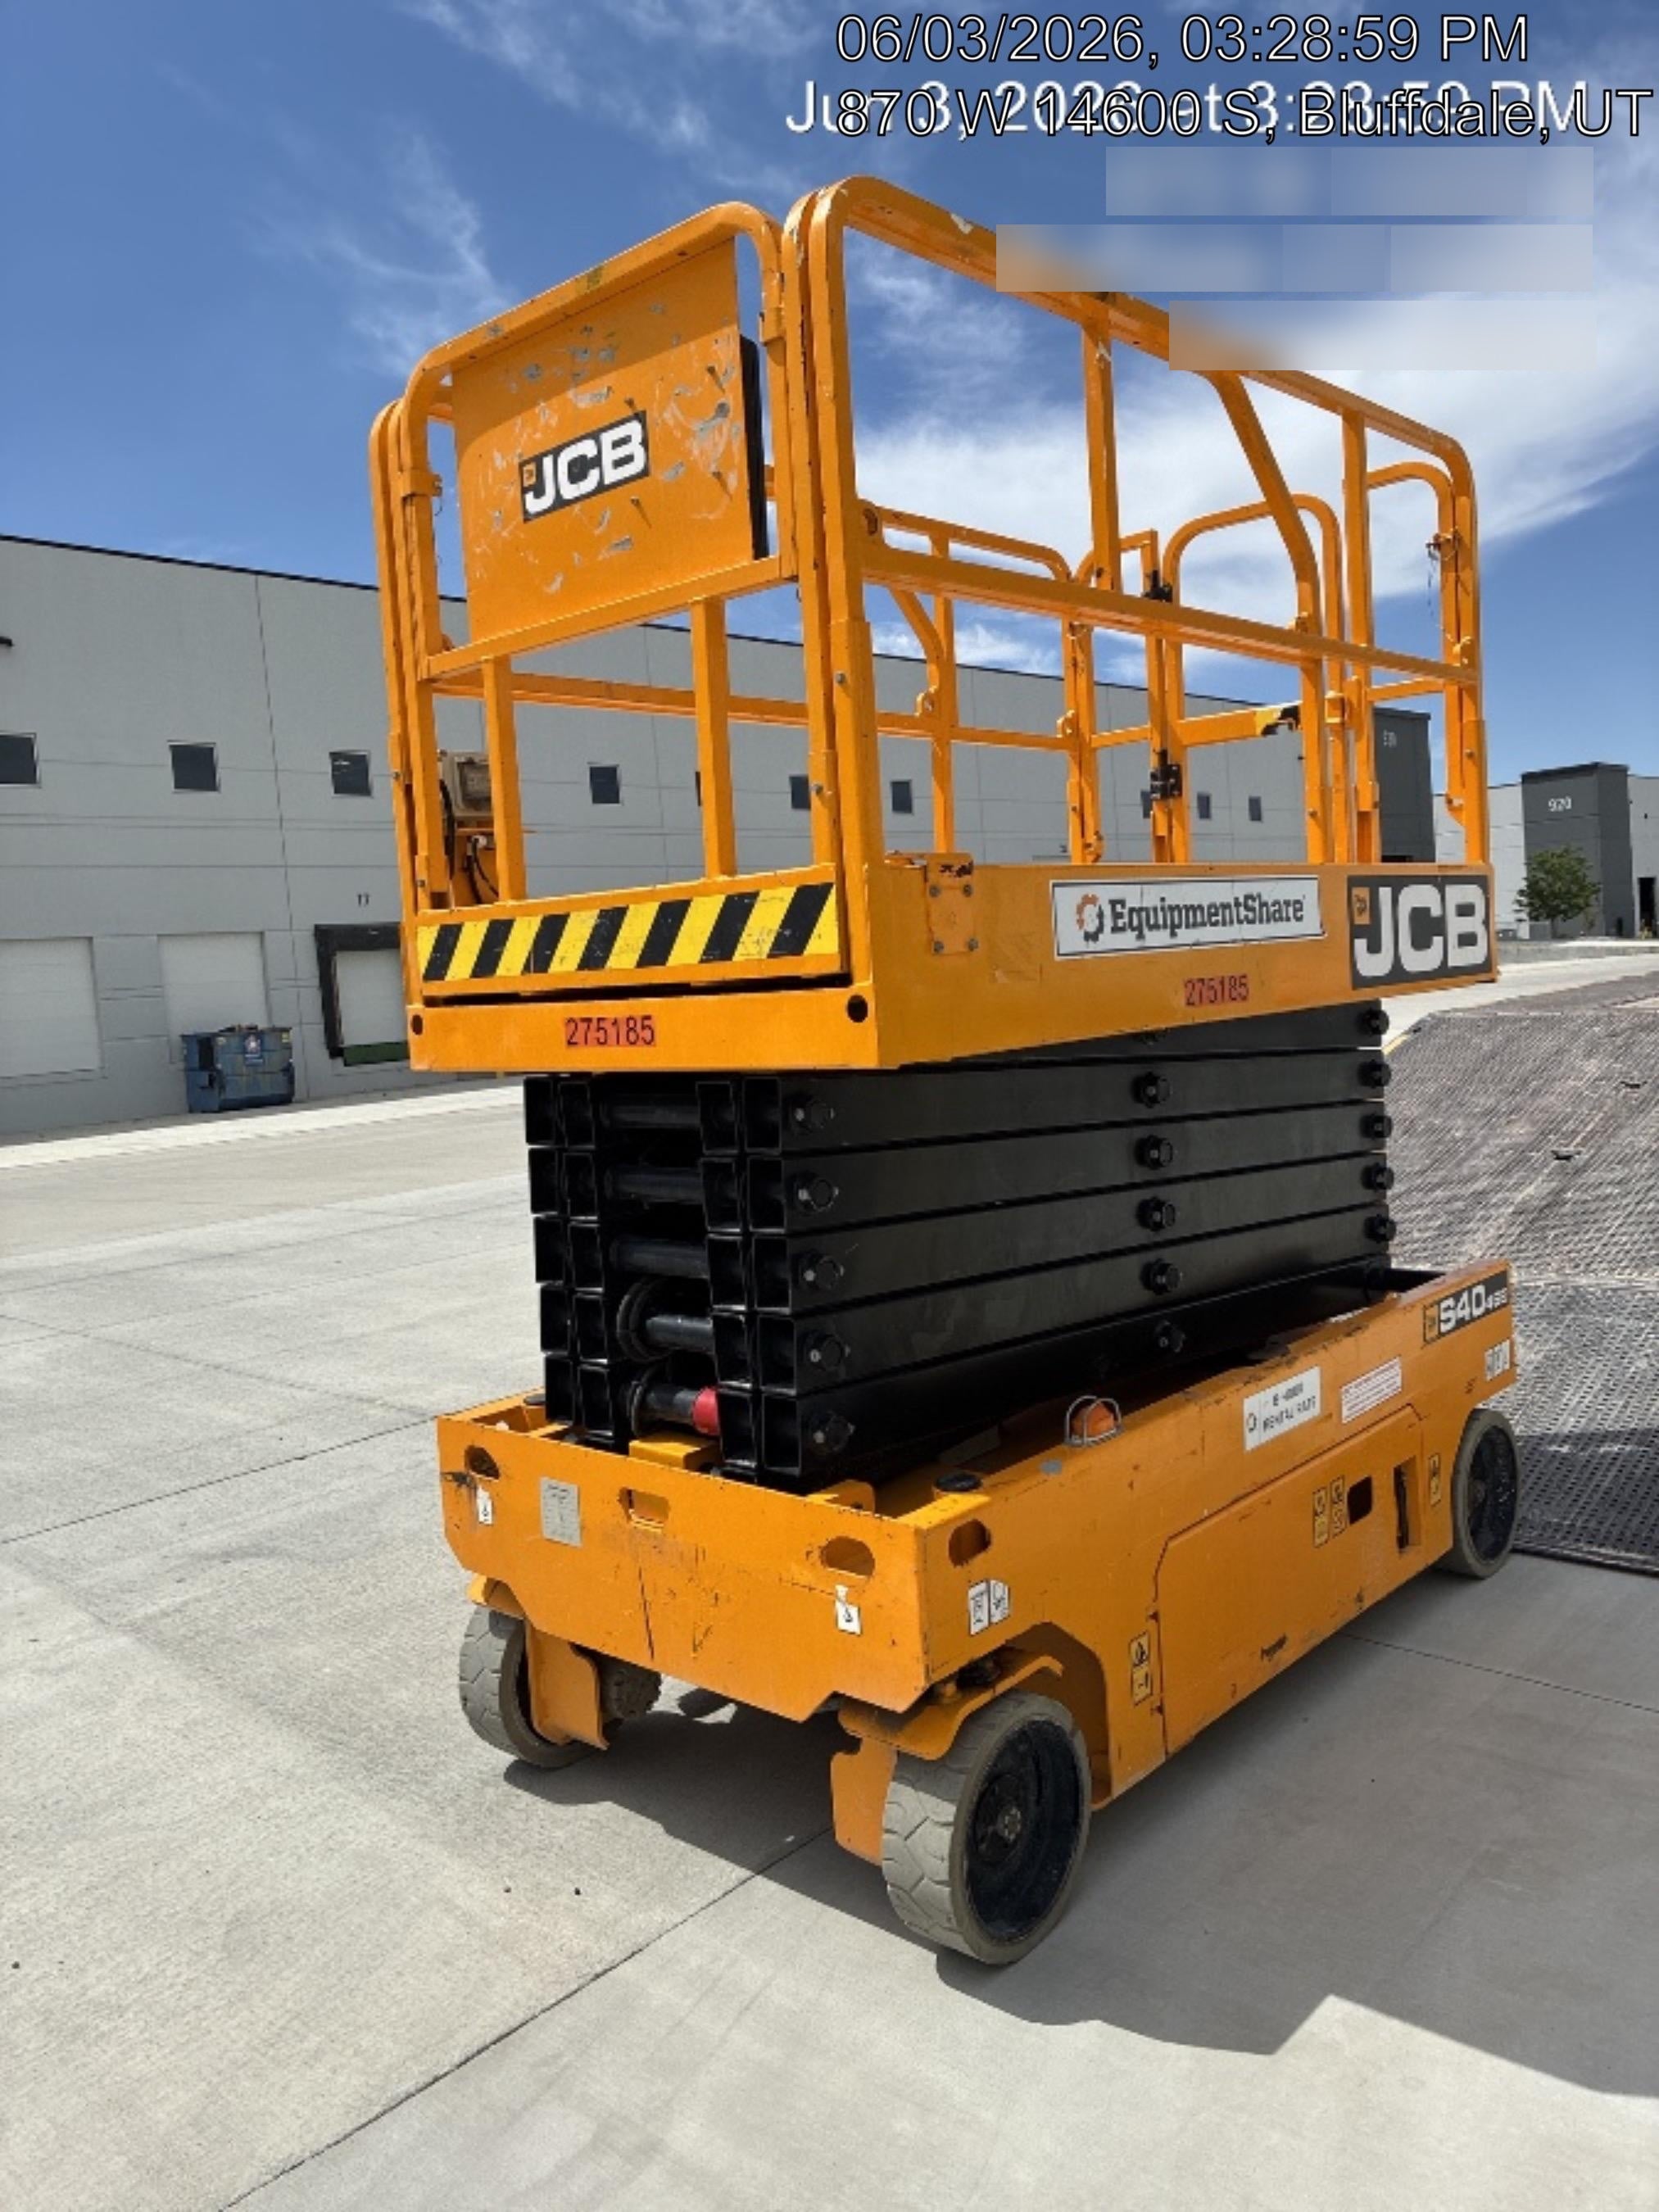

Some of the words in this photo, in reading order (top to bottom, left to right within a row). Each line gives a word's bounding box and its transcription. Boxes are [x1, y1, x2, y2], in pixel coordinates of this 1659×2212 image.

[525, 419, 646, 514] JCB
[1548, 796, 1572, 812] 920
[1108, 892, 1304, 940] EquipmentShare
[1353, 884, 1489, 977] JCB
[1184, 974, 1250, 1007] 275185
[566, 1015, 655, 1045] 275185
